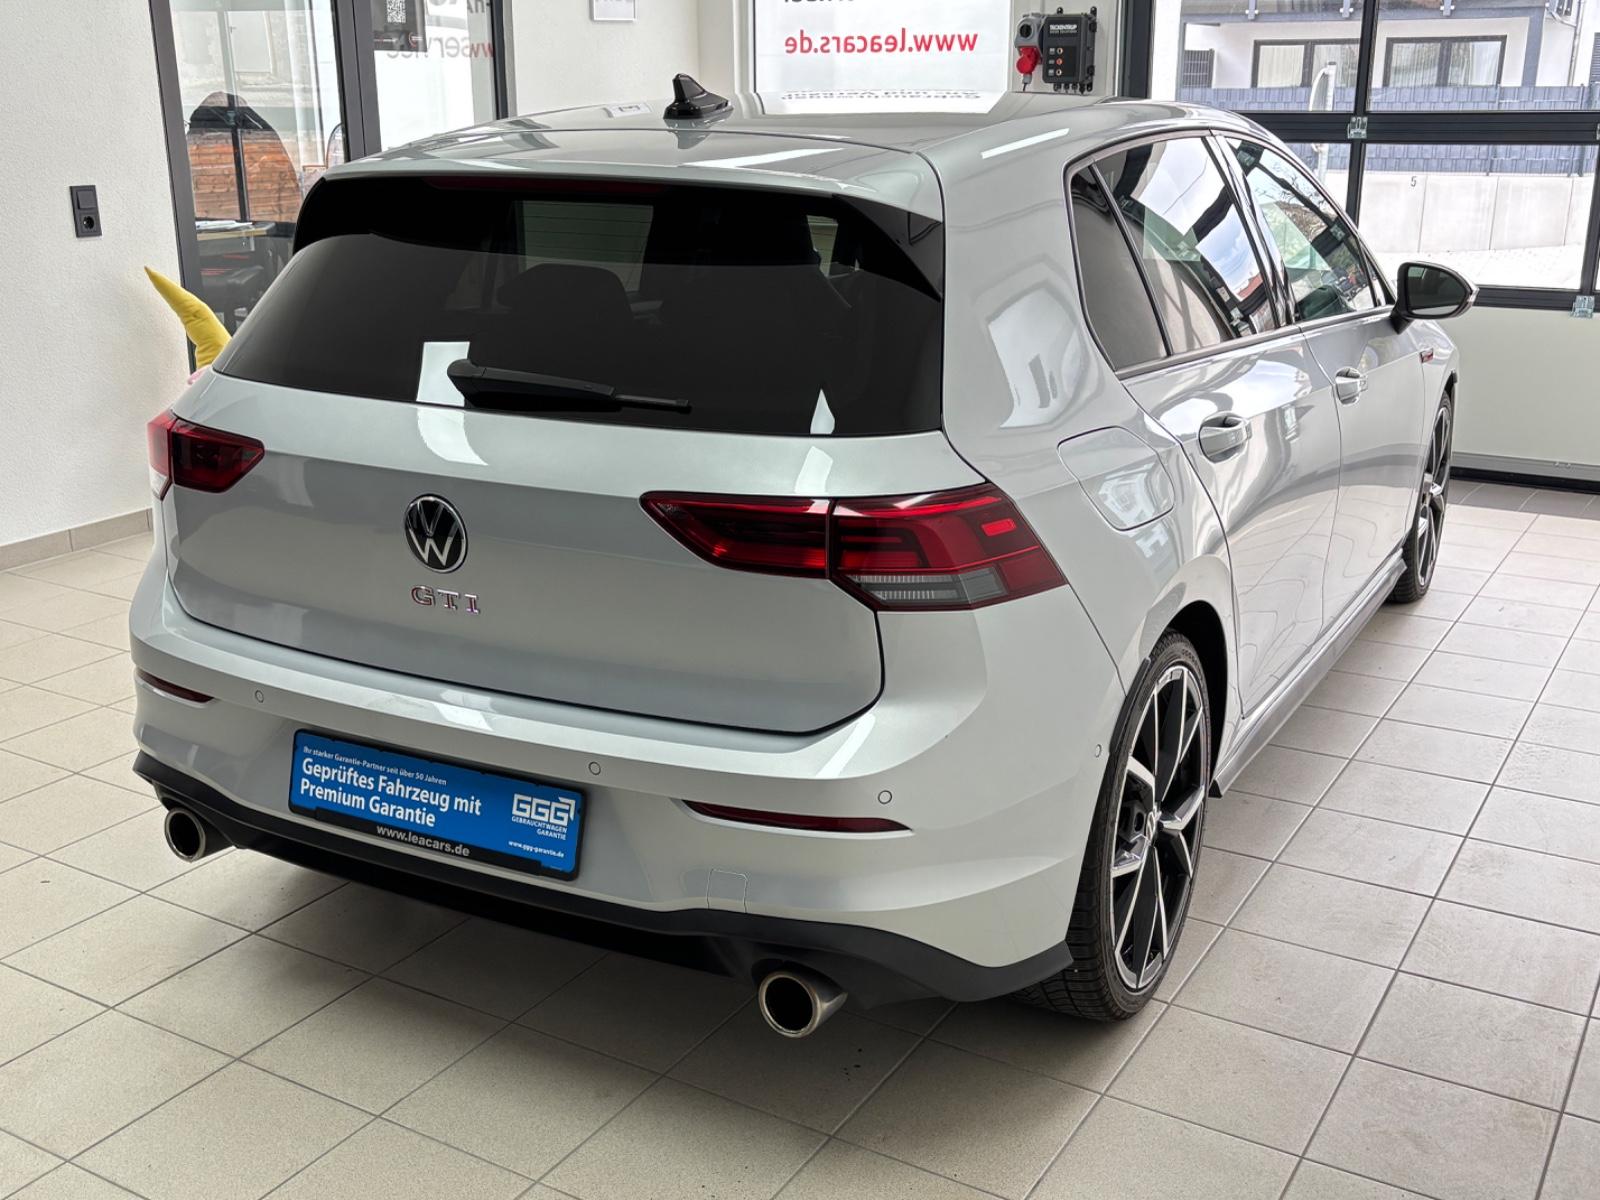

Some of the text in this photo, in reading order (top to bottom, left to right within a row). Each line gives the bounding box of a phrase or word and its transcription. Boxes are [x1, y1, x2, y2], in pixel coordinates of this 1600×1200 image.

[407, 497, 465, 569] VW
[411, 585, 479, 614] GTI
[303, 746, 447, 786] Ihr starker Garantie-Partner seit über 50 Jahren
[300, 778, 436, 828] Premium Garantie
[302, 758, 482, 816] Geprüftes Fahrzeug mit
[511, 816, 568, 834] GEBRAUCHTWAGEN
[512, 793, 571, 827] GGG
[376, 825, 470, 857] www.leacars.de
[537, 828, 567, 841] GARANTIE
